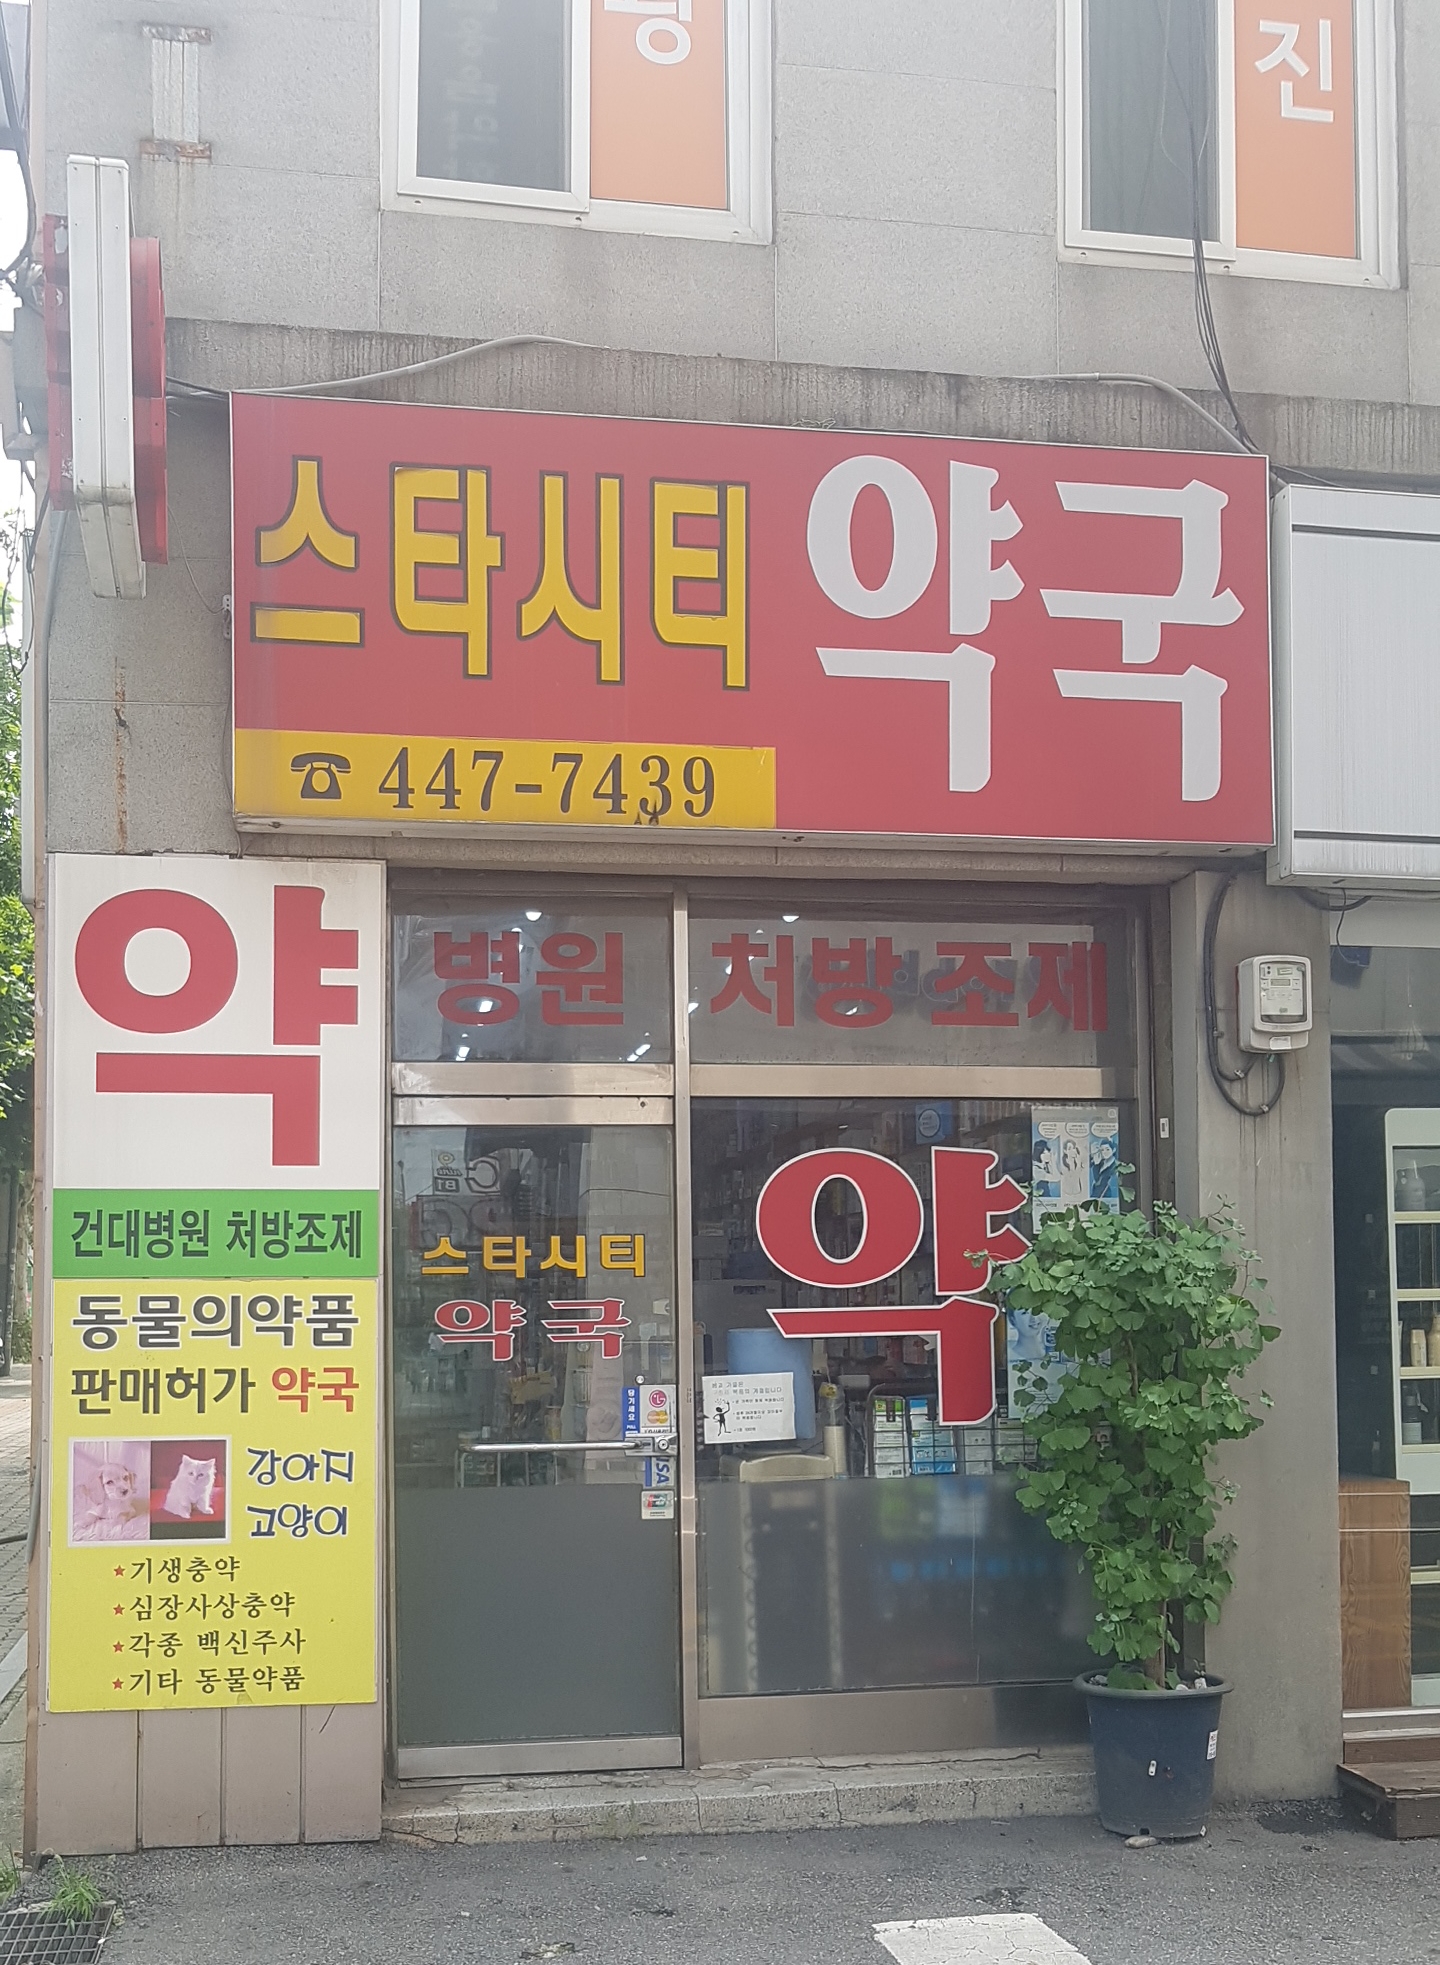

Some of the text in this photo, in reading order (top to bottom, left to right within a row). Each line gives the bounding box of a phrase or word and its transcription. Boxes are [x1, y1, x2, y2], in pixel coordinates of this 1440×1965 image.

[1254, 18, 1335, 123] 진
[250, 454, 1245, 802] 스타시티 약국
[378, 746, 716, 818] 447-7439
[433, 931, 625, 1027] 병원
[75, 885, 359, 1166] 약
[71, 1209, 362, 1259] 건대병원 처방조제
[421, 1233, 646, 1279] 스타시티
[756, 1146, 1033, 1426] 약
[72, 1294, 359, 1350] 동물의약품
[434, 1298, 632, 1362] 약국
[71, 1366, 359, 1415] 판매허가 약국
[247, 1448, 354, 1485] 강아지
[655, 1456, 670, 1485] ISA
[247, 1503, 347, 1538] 고양이
[130, 1555, 241, 1585] 기생충약
[129, 1591, 296, 1622] 심장사상충약
[128, 1628, 307, 1659] 각종 백신주사
[129, 1665, 306, 1697] 기타 동물약품
